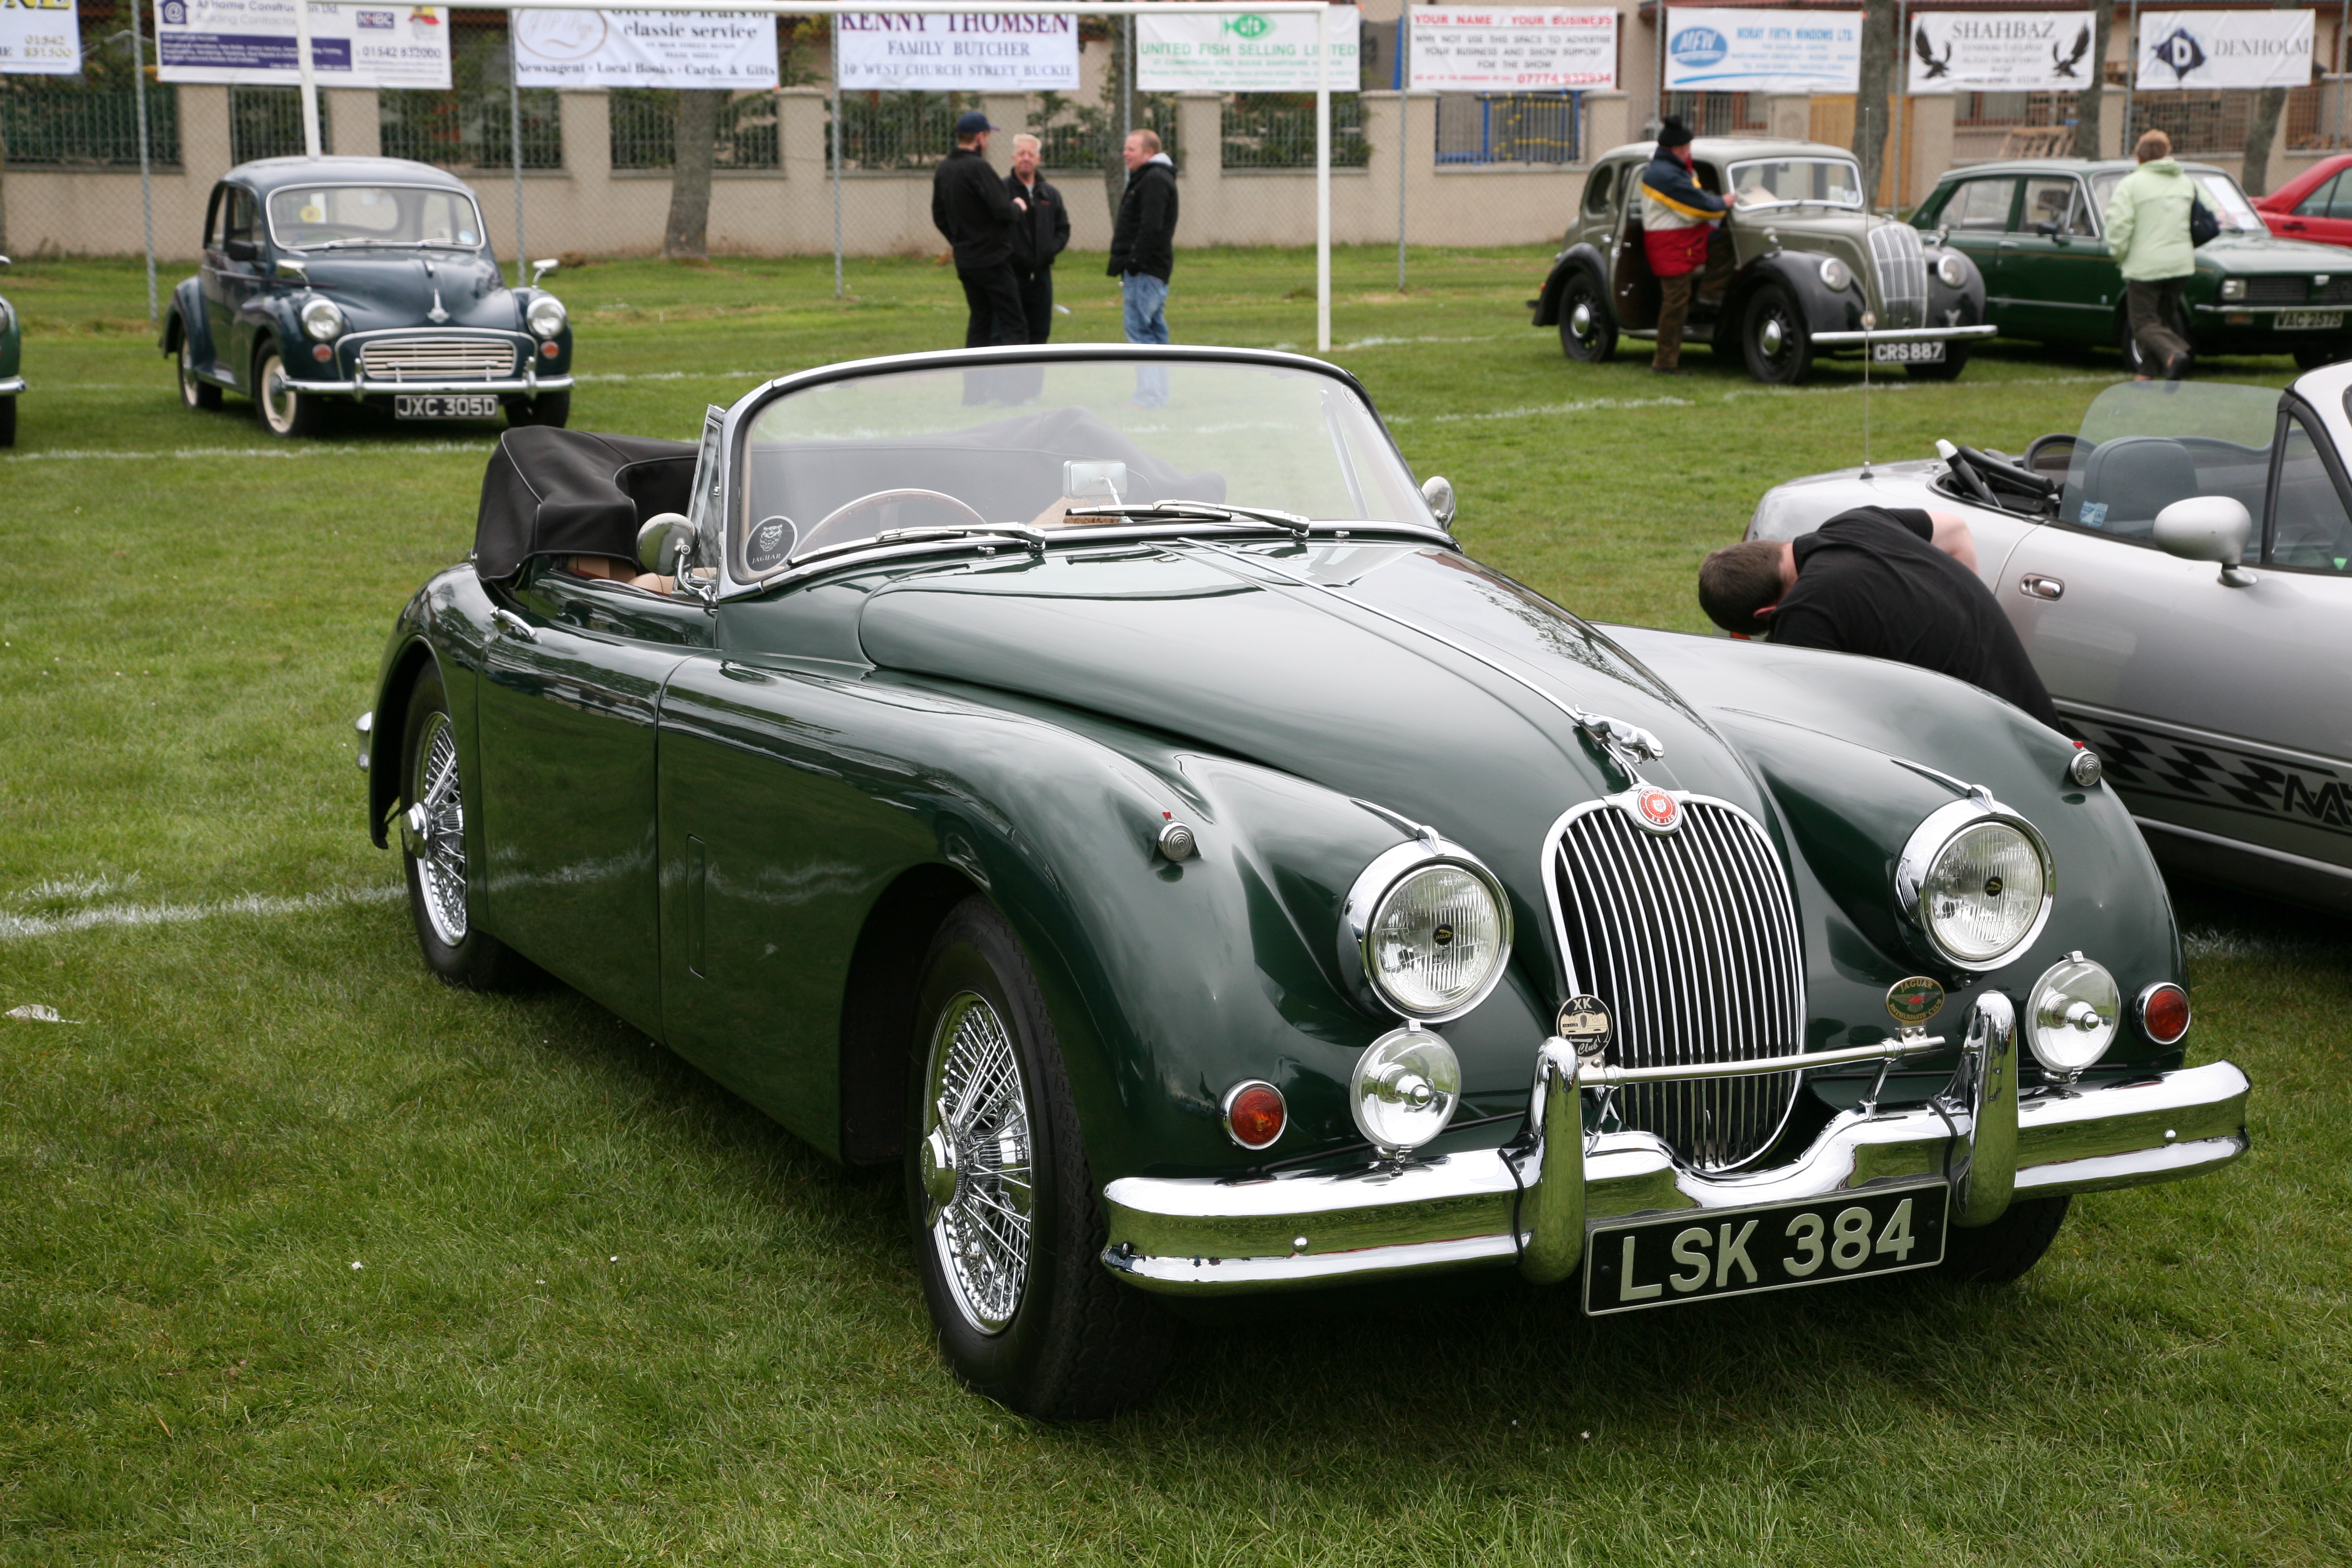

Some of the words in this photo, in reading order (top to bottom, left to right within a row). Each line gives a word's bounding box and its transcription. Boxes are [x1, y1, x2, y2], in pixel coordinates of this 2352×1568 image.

[195, 13, 236, 25] Building
[841, 13, 926, 31] KENNY
[948, 13, 1069, 33] THOMSEN
[1415, 15, 1448, 24] YOUR
[1457, 15, 1492, 25] NAME
[1511, 15, 1544, 25] YOUR
[1552, 15, 1612, 26] BUSINESS
[624, 21, 685, 37] classic
[691, 23, 757, 38] service
[1796, 29, 1834, 40] WINDOWS
[1953, 20, 2056, 38] SHAHBAZ
[888, 40, 943, 55] FAMILY
[954, 41, 1030, 56] BUTCHER
[1677, 30, 1719, 52] MFW
[2214, 38, 2310, 57] DENHOLM
[1140, 43, 1192, 55] UNITED
[1199, 44, 1231, 56] FISH
[1238, 44, 1296, 56] SELLING
[517, 61, 586, 75] Newsagent
[596, 62, 631, 73] Local
[636, 63, 674, 74] Books
[684, 63, 722, 75] Cards
[746, 64, 775, 76] Gifts
[843, 63, 857, 75] 10
[863, 62, 901, 75] WEST
[905, 63, 962, 76] CHURCH
[969, 64, 1018, 76] STREET
[1024, 64, 1072, 76] BUCKIE
[1877, 343, 1909, 361] CRS
[1910, 341, 1943, 360] 887
[399, 398, 439, 416] JXC
[443, 397, 496, 416] 305D
[751, 553, 781, 564] JAGUAR
[1900, 979, 1934, 993] JAGUAR
[1573, 997, 1593, 1011] XK
[1928, 998, 1942, 1015] CLUB
[1577, 1038, 1599, 1055] Club
[1620, 1220, 1758, 1301] LSK
[1783, 1198, 1915, 1277] 384
